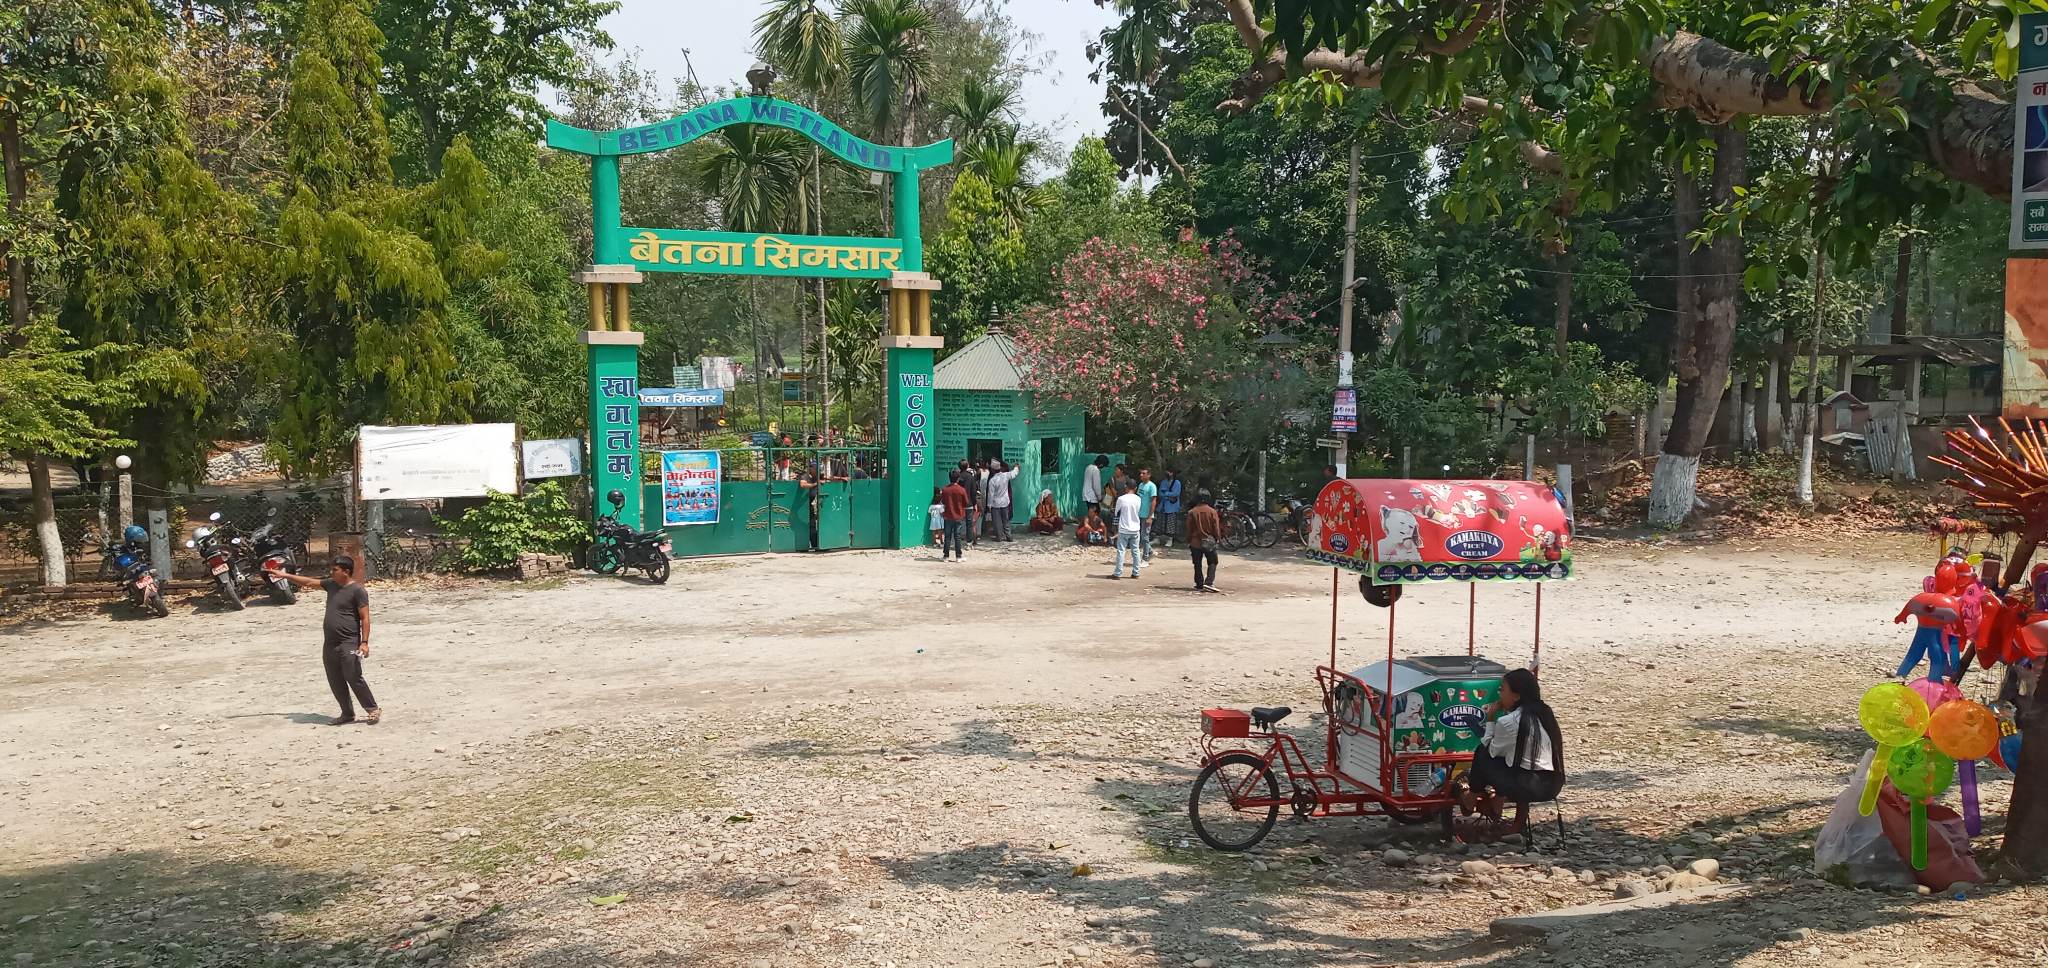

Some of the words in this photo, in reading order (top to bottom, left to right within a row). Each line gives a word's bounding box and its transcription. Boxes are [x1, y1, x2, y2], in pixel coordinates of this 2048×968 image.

[618, 103, 739, 152] BETANA
[751, 99, 892, 169] WETLAND
[629, 232, 746, 266] बेतना
[752, 235, 903, 271] सिमसार
[1450, 531, 1499, 547] KAMAKHYA
[1442, 705, 1482, 719] KAMAKHYA
